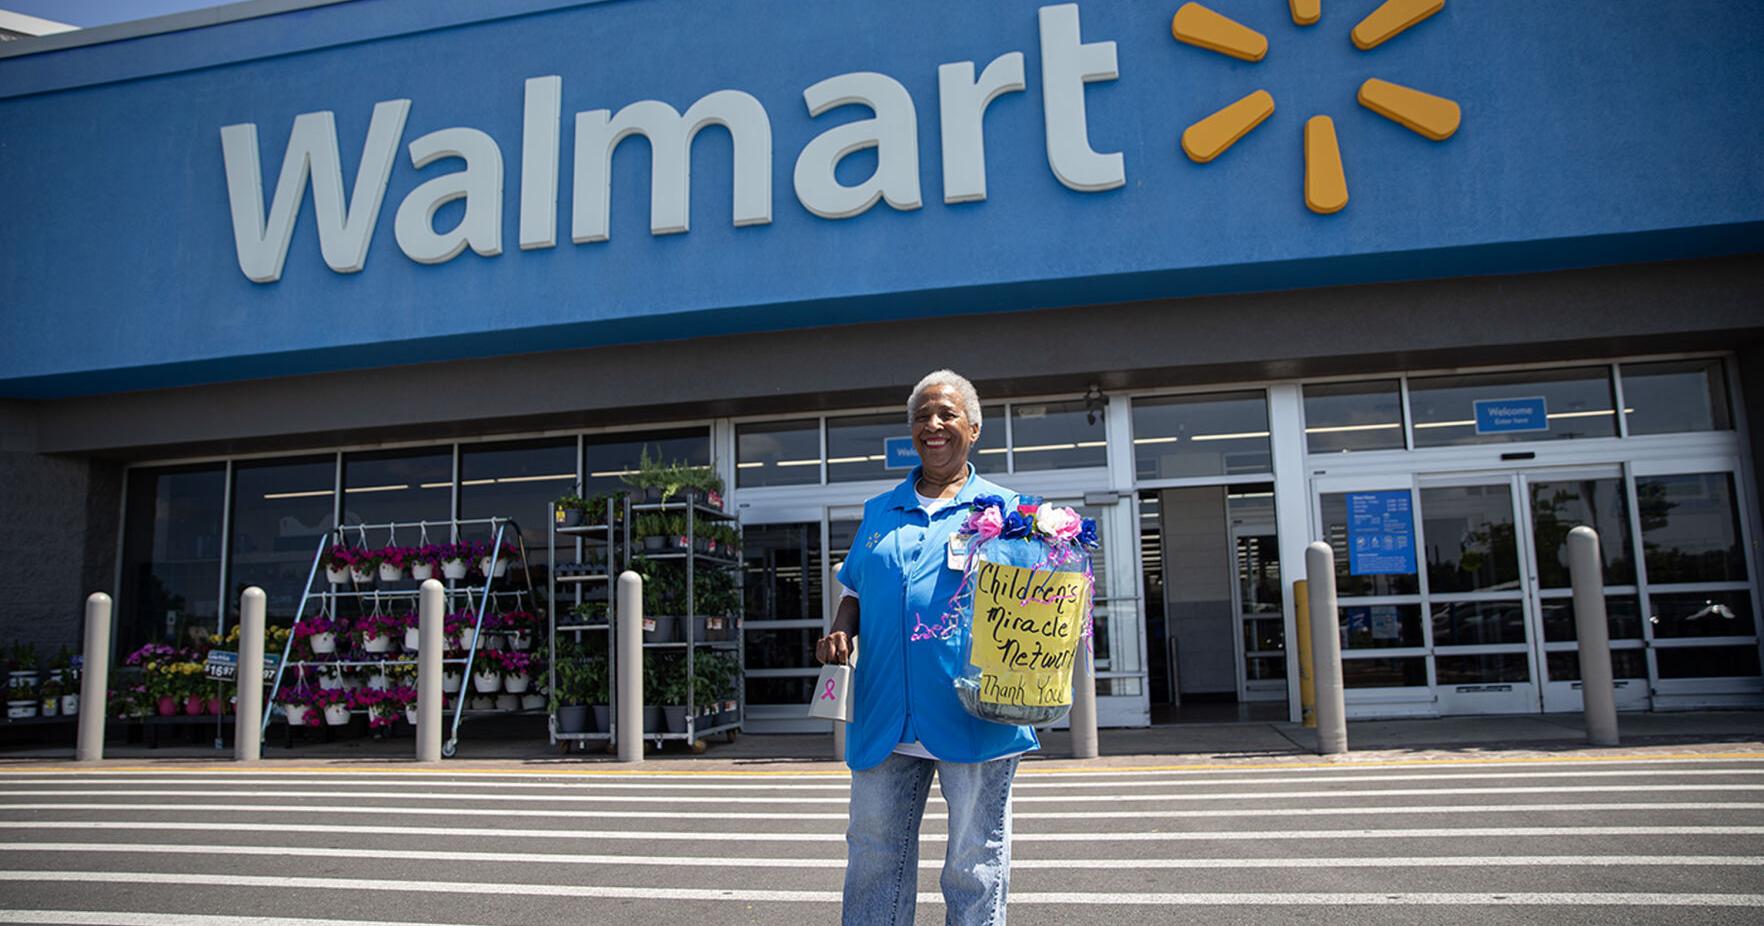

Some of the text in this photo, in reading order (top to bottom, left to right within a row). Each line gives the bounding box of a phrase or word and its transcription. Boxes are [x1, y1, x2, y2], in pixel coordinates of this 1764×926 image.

[219, 3, 1126, 283] Walmart
[1487, 406, 1533, 417] Welcome
[978, 563, 1078, 614] Children's
[986, 606, 1068, 643] Miracle
[982, 674, 1027, 706] Thank
